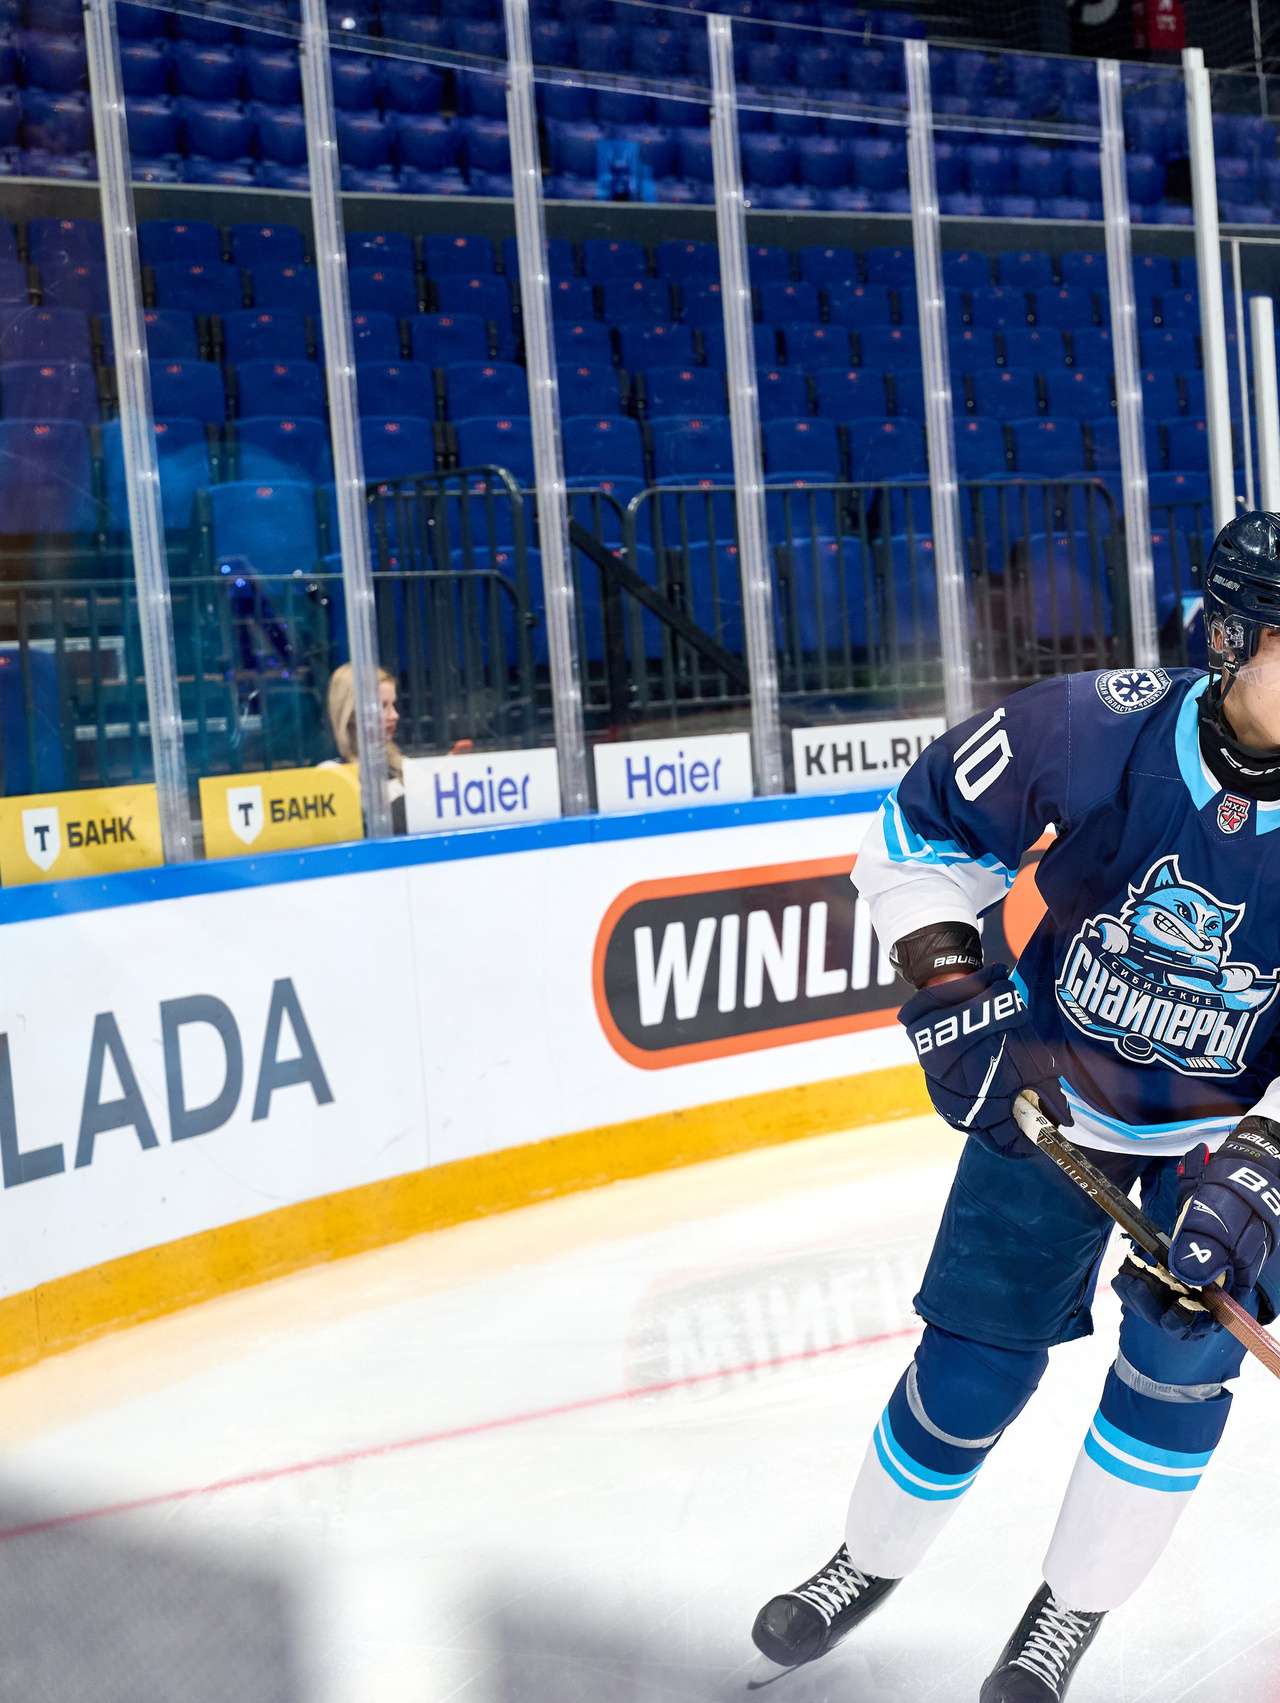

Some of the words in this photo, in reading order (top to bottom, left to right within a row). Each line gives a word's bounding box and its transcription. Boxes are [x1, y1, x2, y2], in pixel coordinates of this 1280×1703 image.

[625, 751, 721, 800] Haier
[953, 707, 1014, 801] 10
[269, 793, 337, 825] БАНК
[434, 767, 531, 819] Haier
[1224, 799, 1246, 814] МХЛ
[66, 816, 136, 849] БАНК
[633, 897, 897, 1028] WINLI
[1110, 961, 1213, 1006] СИБИРСКИЕ
[0, 976, 335, 1190] LADA
